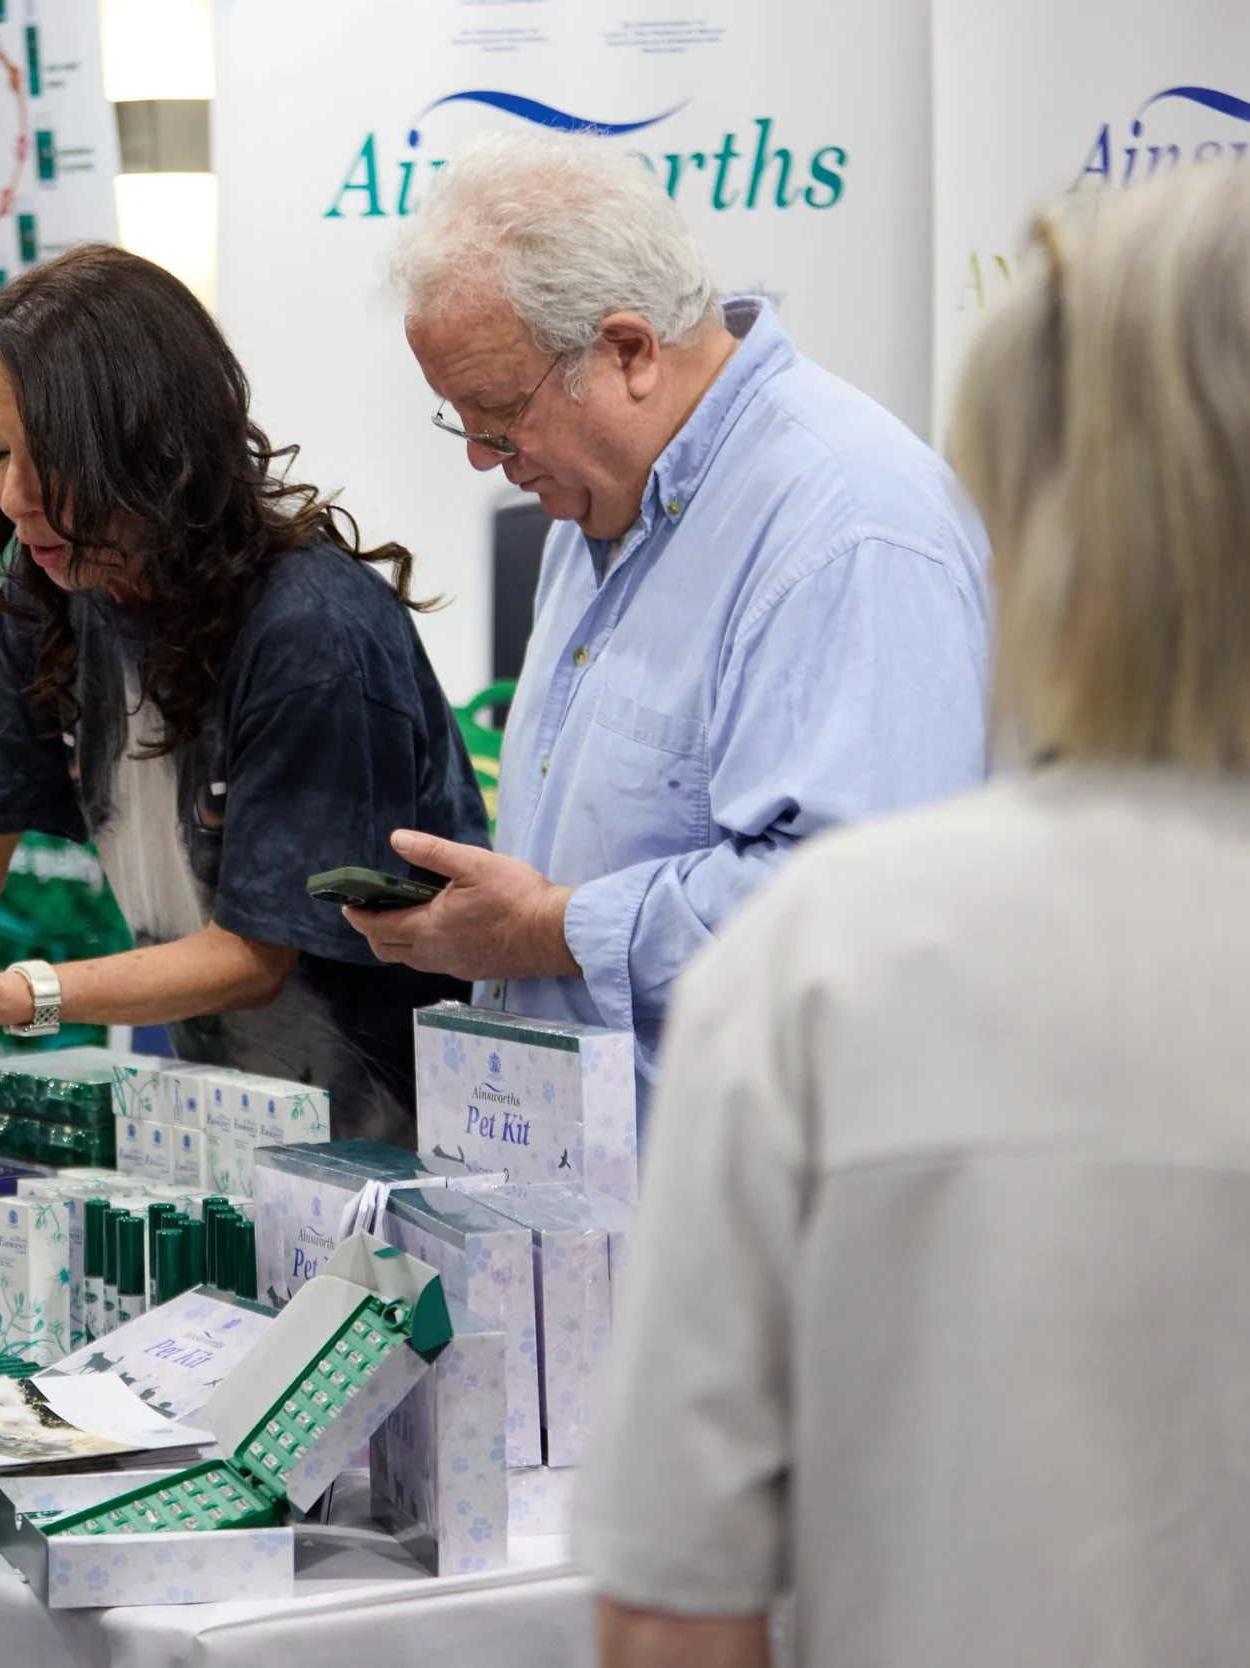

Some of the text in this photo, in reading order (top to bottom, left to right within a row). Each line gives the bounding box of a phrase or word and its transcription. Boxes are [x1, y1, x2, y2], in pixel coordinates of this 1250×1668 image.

[322, 117, 848, 218] Airths
[471, 1084, 521, 1107] Ainsworths
[465, 1104, 531, 1147] Pet Kit
[292, 1247, 318, 1280] Pet
[143, 1338, 213, 1369] Pet Kit
